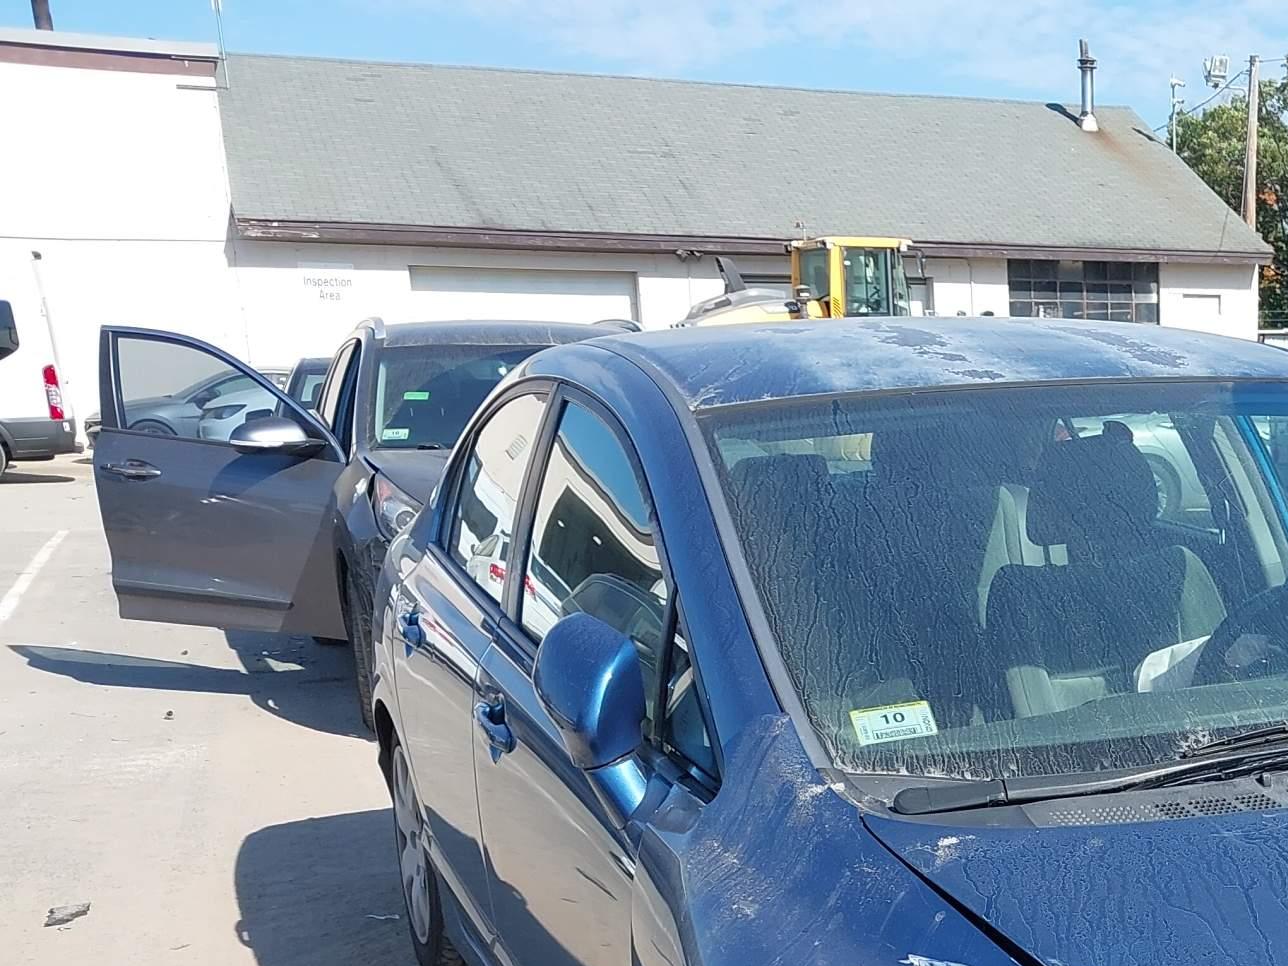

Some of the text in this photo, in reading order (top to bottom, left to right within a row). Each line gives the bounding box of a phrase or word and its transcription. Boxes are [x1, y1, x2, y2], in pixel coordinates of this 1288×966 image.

[303, 276, 352, 288] Inspection
[320, 289, 341, 301] Area
[880, 712, 905, 725] 10
